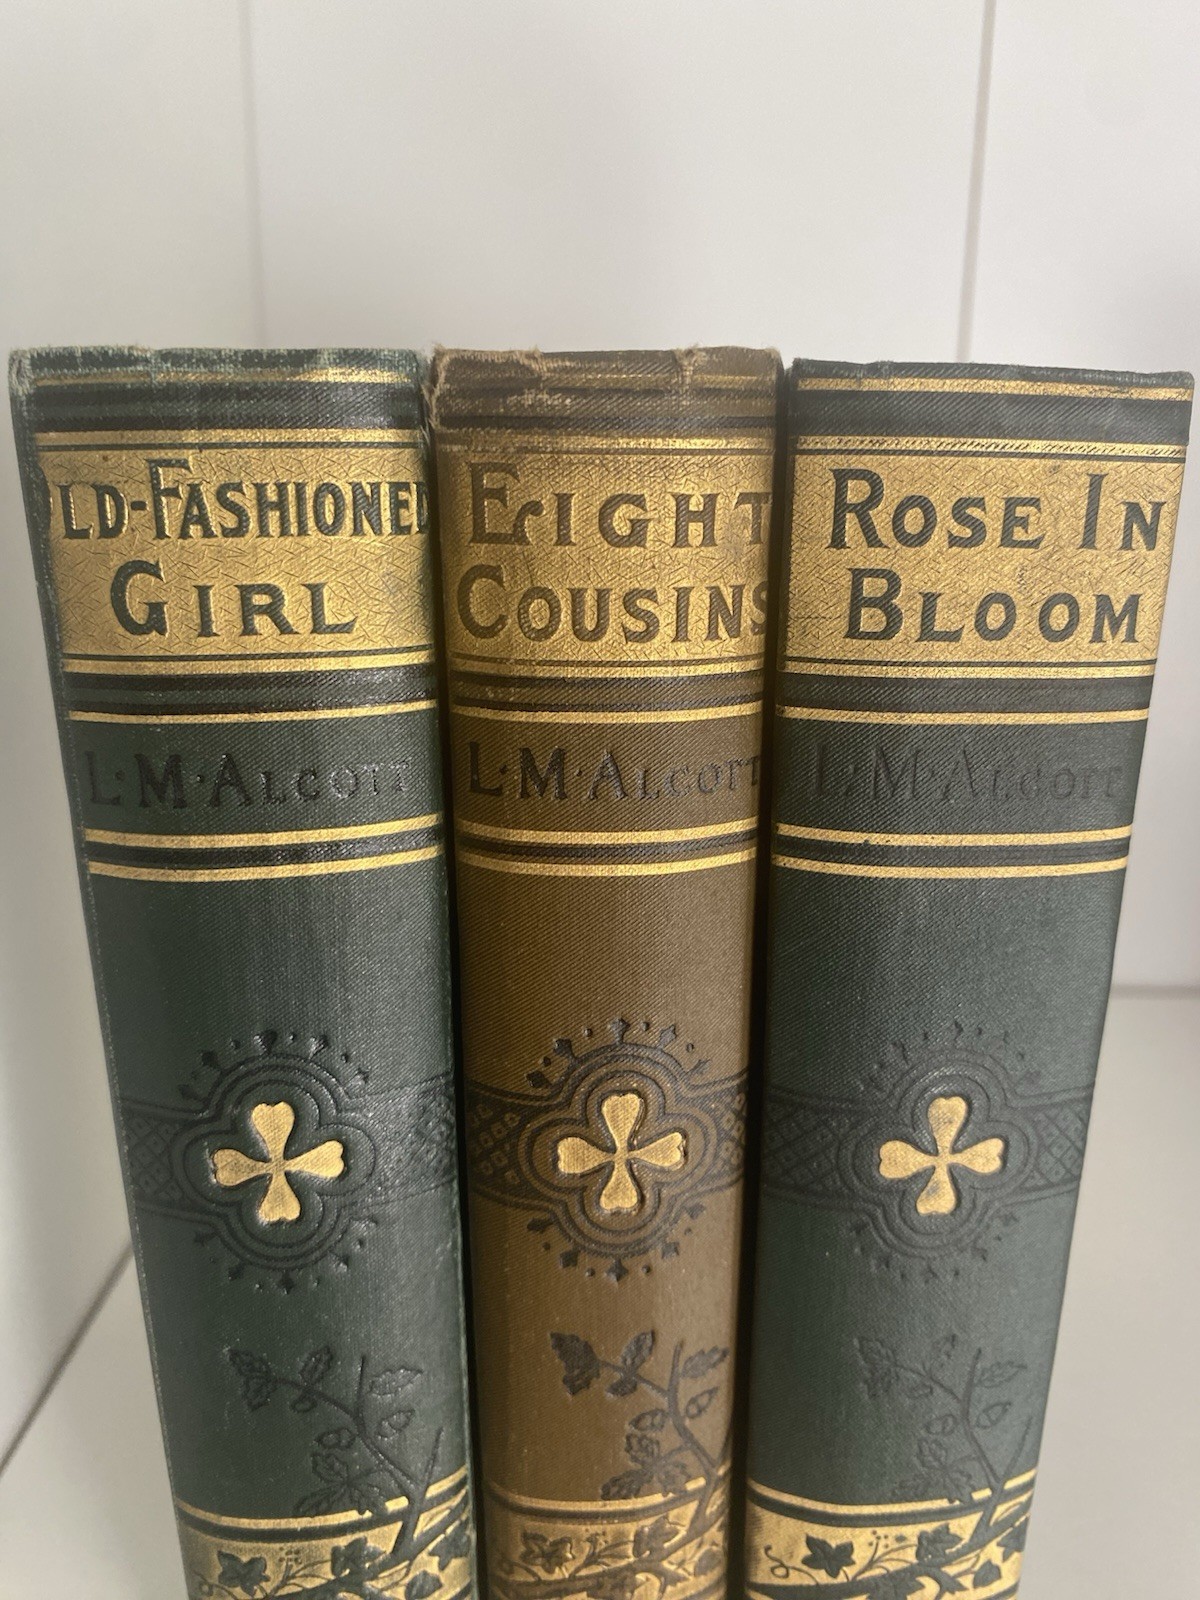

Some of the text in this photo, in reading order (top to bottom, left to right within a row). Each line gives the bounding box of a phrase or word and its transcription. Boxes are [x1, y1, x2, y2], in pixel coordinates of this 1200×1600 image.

[824, 467, 1166, 552] ROSE IN
[110, 560, 358, 638] GIRL
[842, 567, 1142, 644] BLOOM
